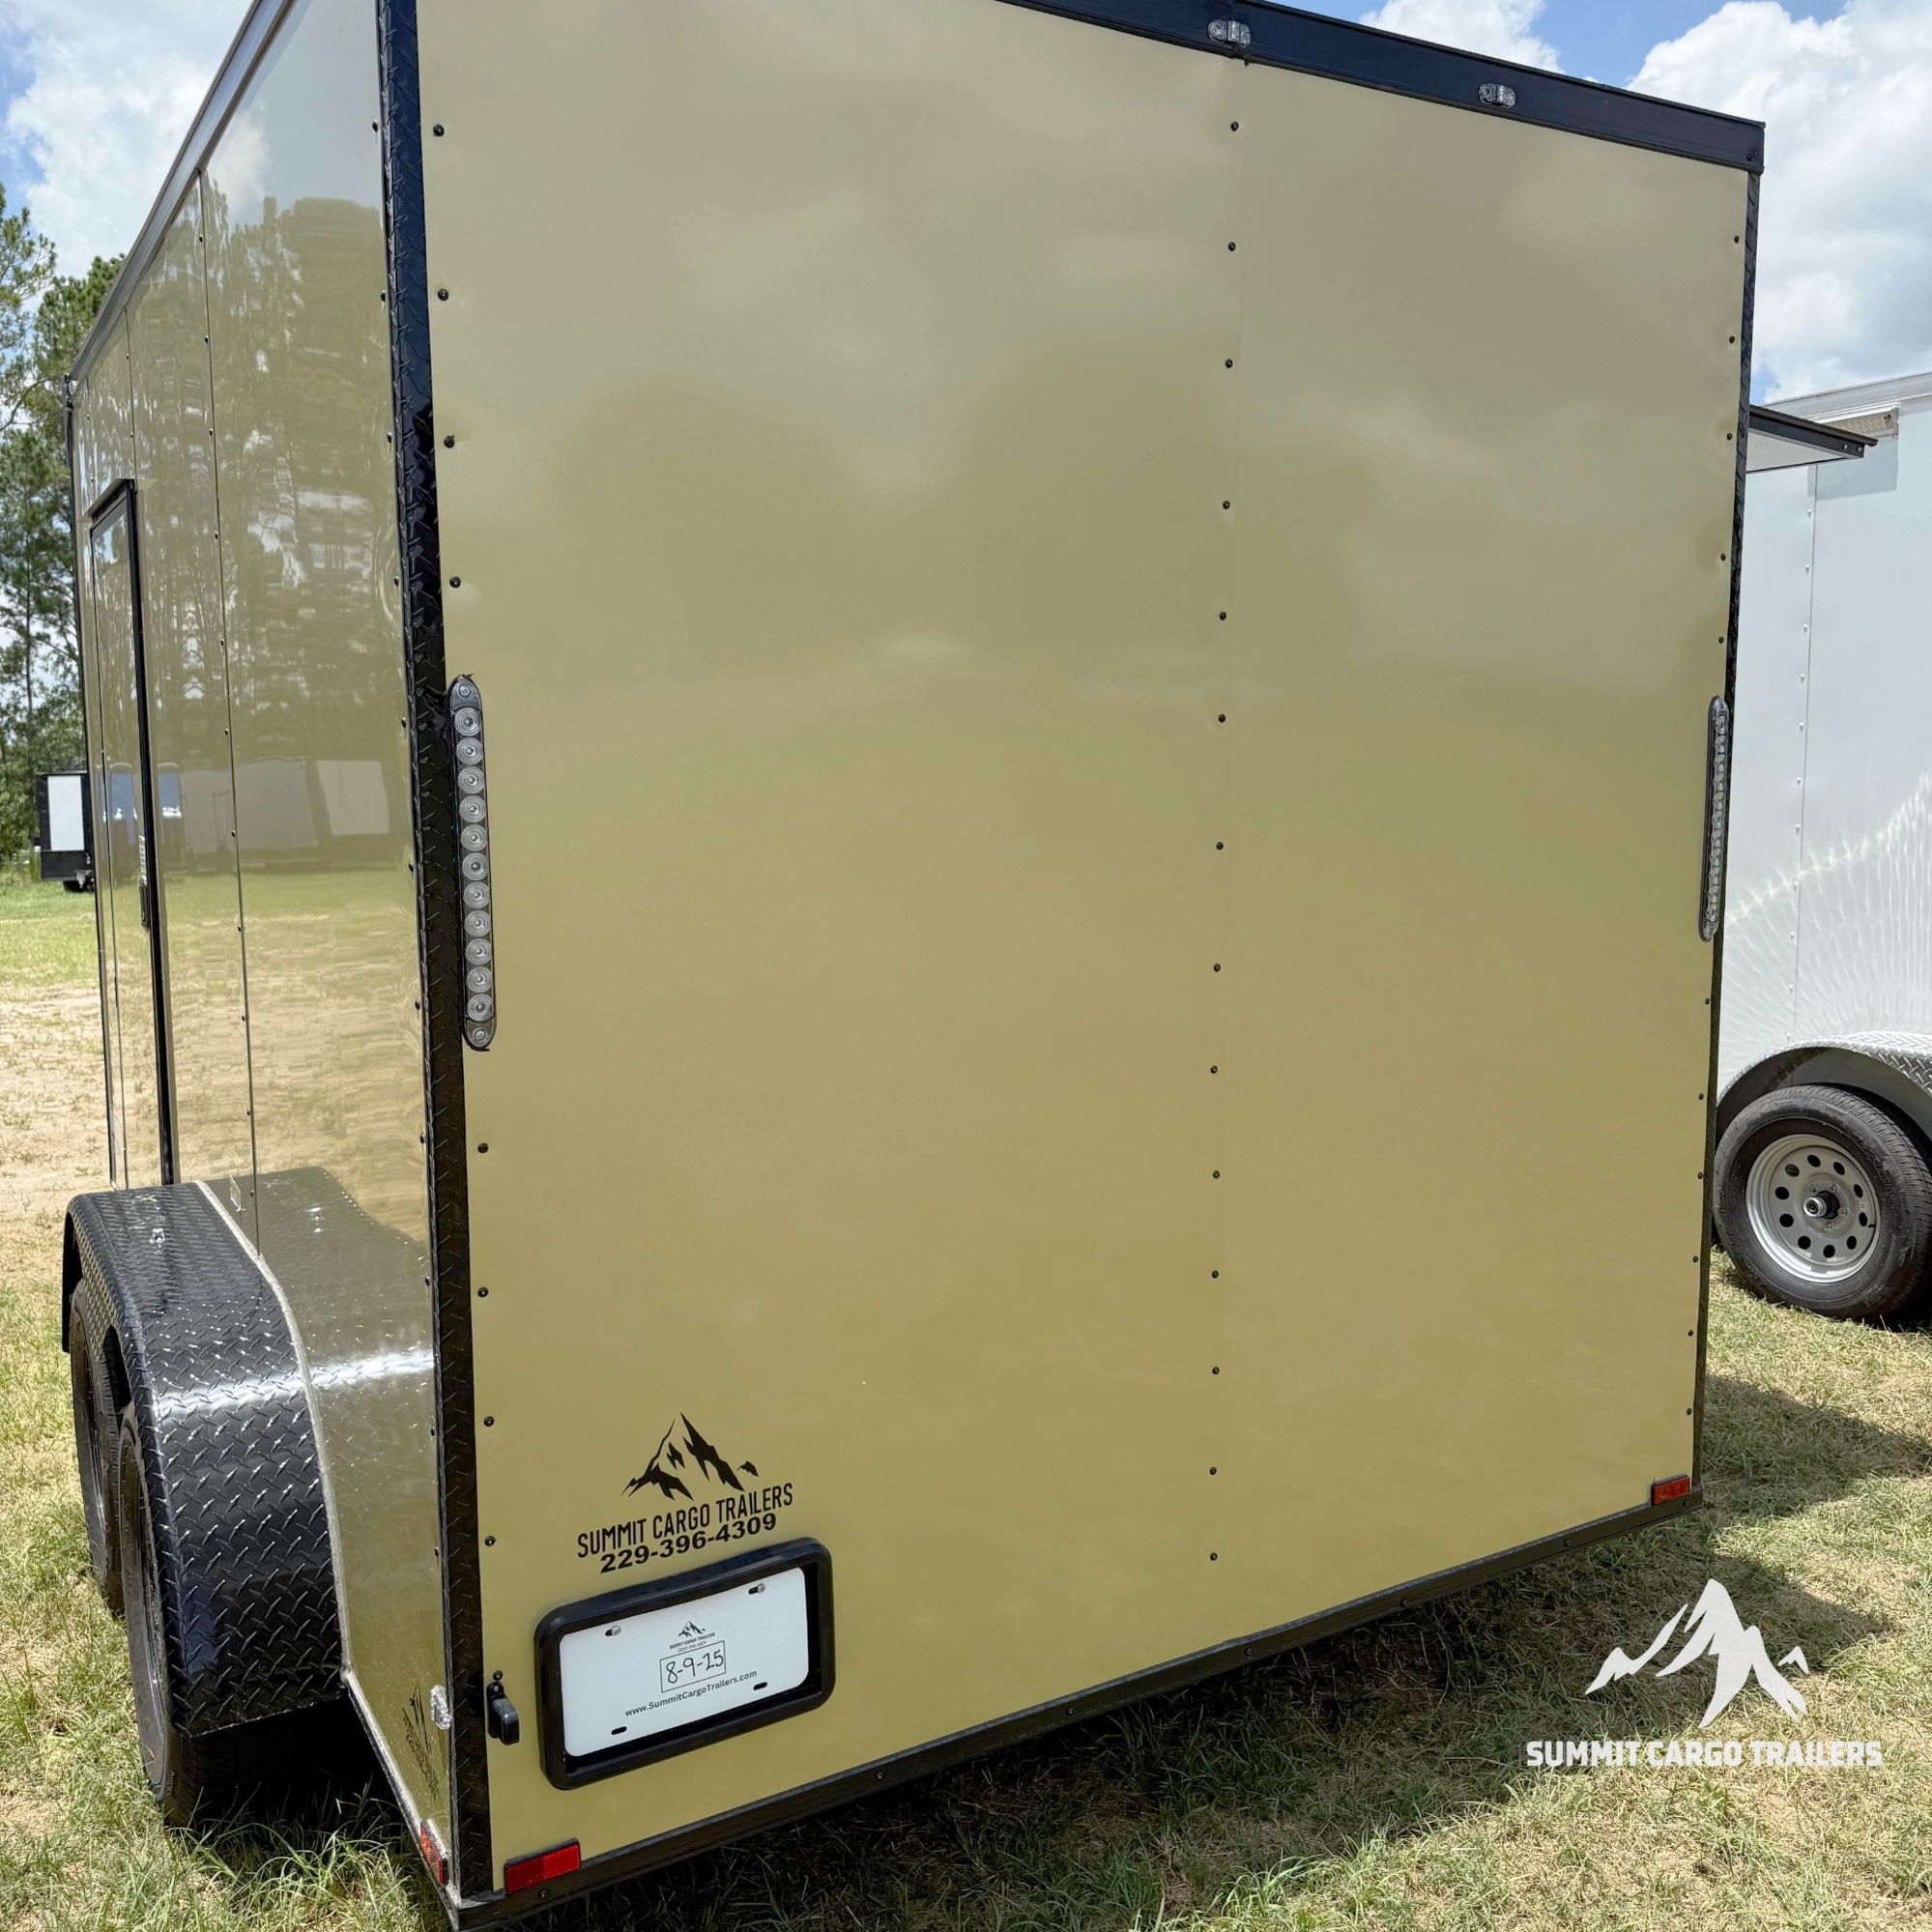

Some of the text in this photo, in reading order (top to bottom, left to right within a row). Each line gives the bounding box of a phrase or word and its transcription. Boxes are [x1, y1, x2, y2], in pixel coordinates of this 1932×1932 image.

[577, 1483, 793, 1558] SUMMIT CARGO TRAILERS
[600, 1513, 776, 1573] 229-396-4309
[624, 1670, 758, 1716] www.SummitCargoTrailers.com
[665, 1649, 724, 1684] 8-9-25
